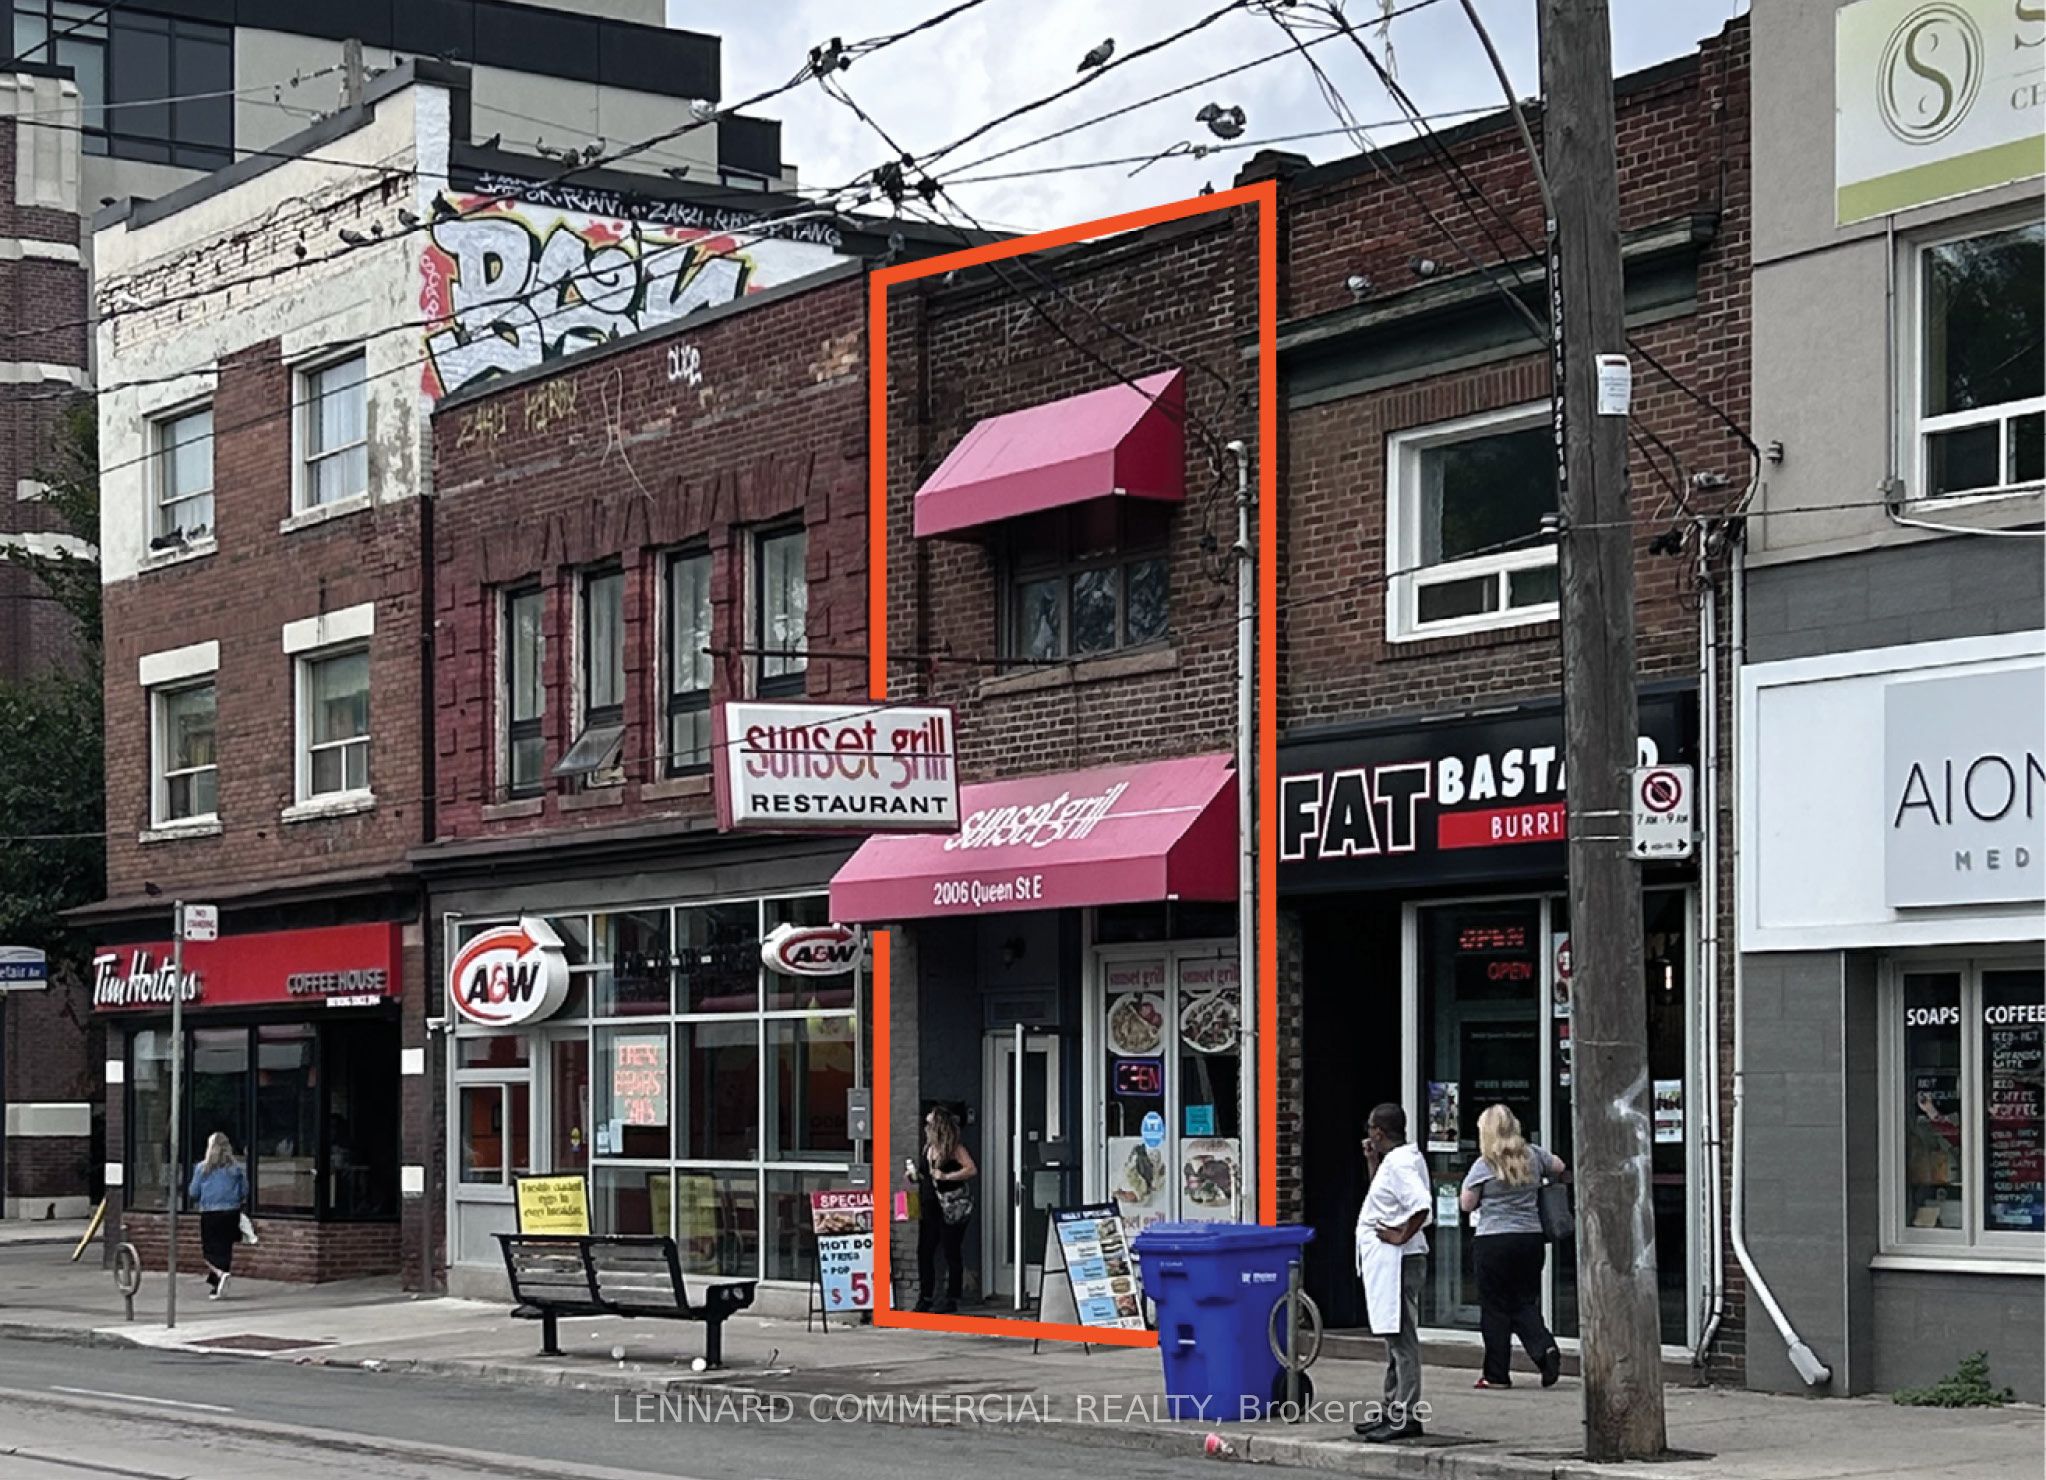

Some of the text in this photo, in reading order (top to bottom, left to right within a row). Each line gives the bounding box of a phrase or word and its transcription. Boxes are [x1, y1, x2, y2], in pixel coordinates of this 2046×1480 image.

[746, 716, 948, 790] sunset grill
[751, 794, 948, 814] RESTAURANT
[1281, 761, 1432, 862] FAT
[933, 874, 1042, 907] 2006 Queen St E
[792, 945, 857, 963] A&W
[93, 953, 128, 1006] Tim
[287, 966, 385, 993] COFFEE HOUSE
[1487, 962, 1532, 980] OPEN
[467, 962, 541, 1004] A&W
[1907, 1007, 1959, 1026] SOAPS
[1985, 1004, 2046, 1024] COFFEE
[820, 1240, 848, 1250] HOT
